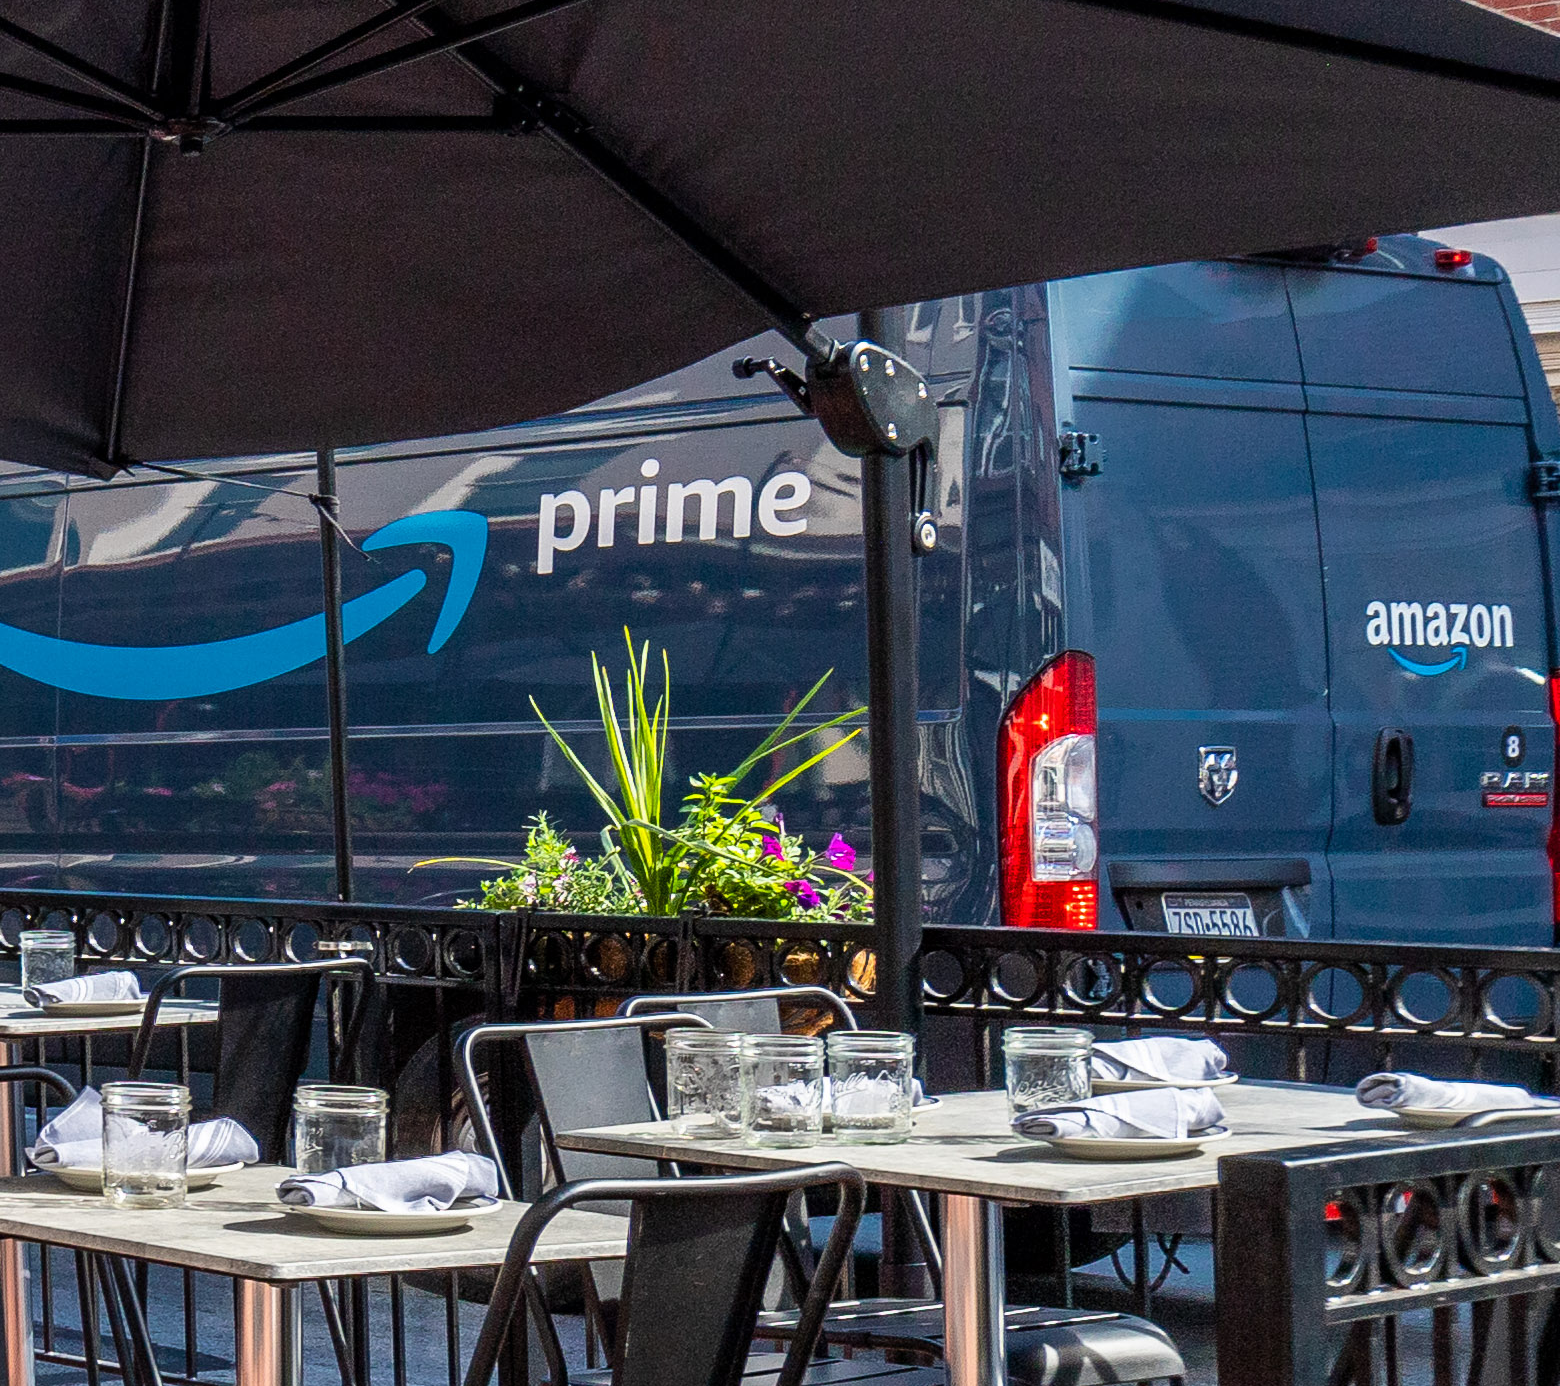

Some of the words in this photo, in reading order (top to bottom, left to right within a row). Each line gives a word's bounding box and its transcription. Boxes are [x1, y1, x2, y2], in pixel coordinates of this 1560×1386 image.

[536, 457, 812, 575] prime
[1366, 600, 1515, 649] amazon
[1507, 735, 1520, 758] 8
